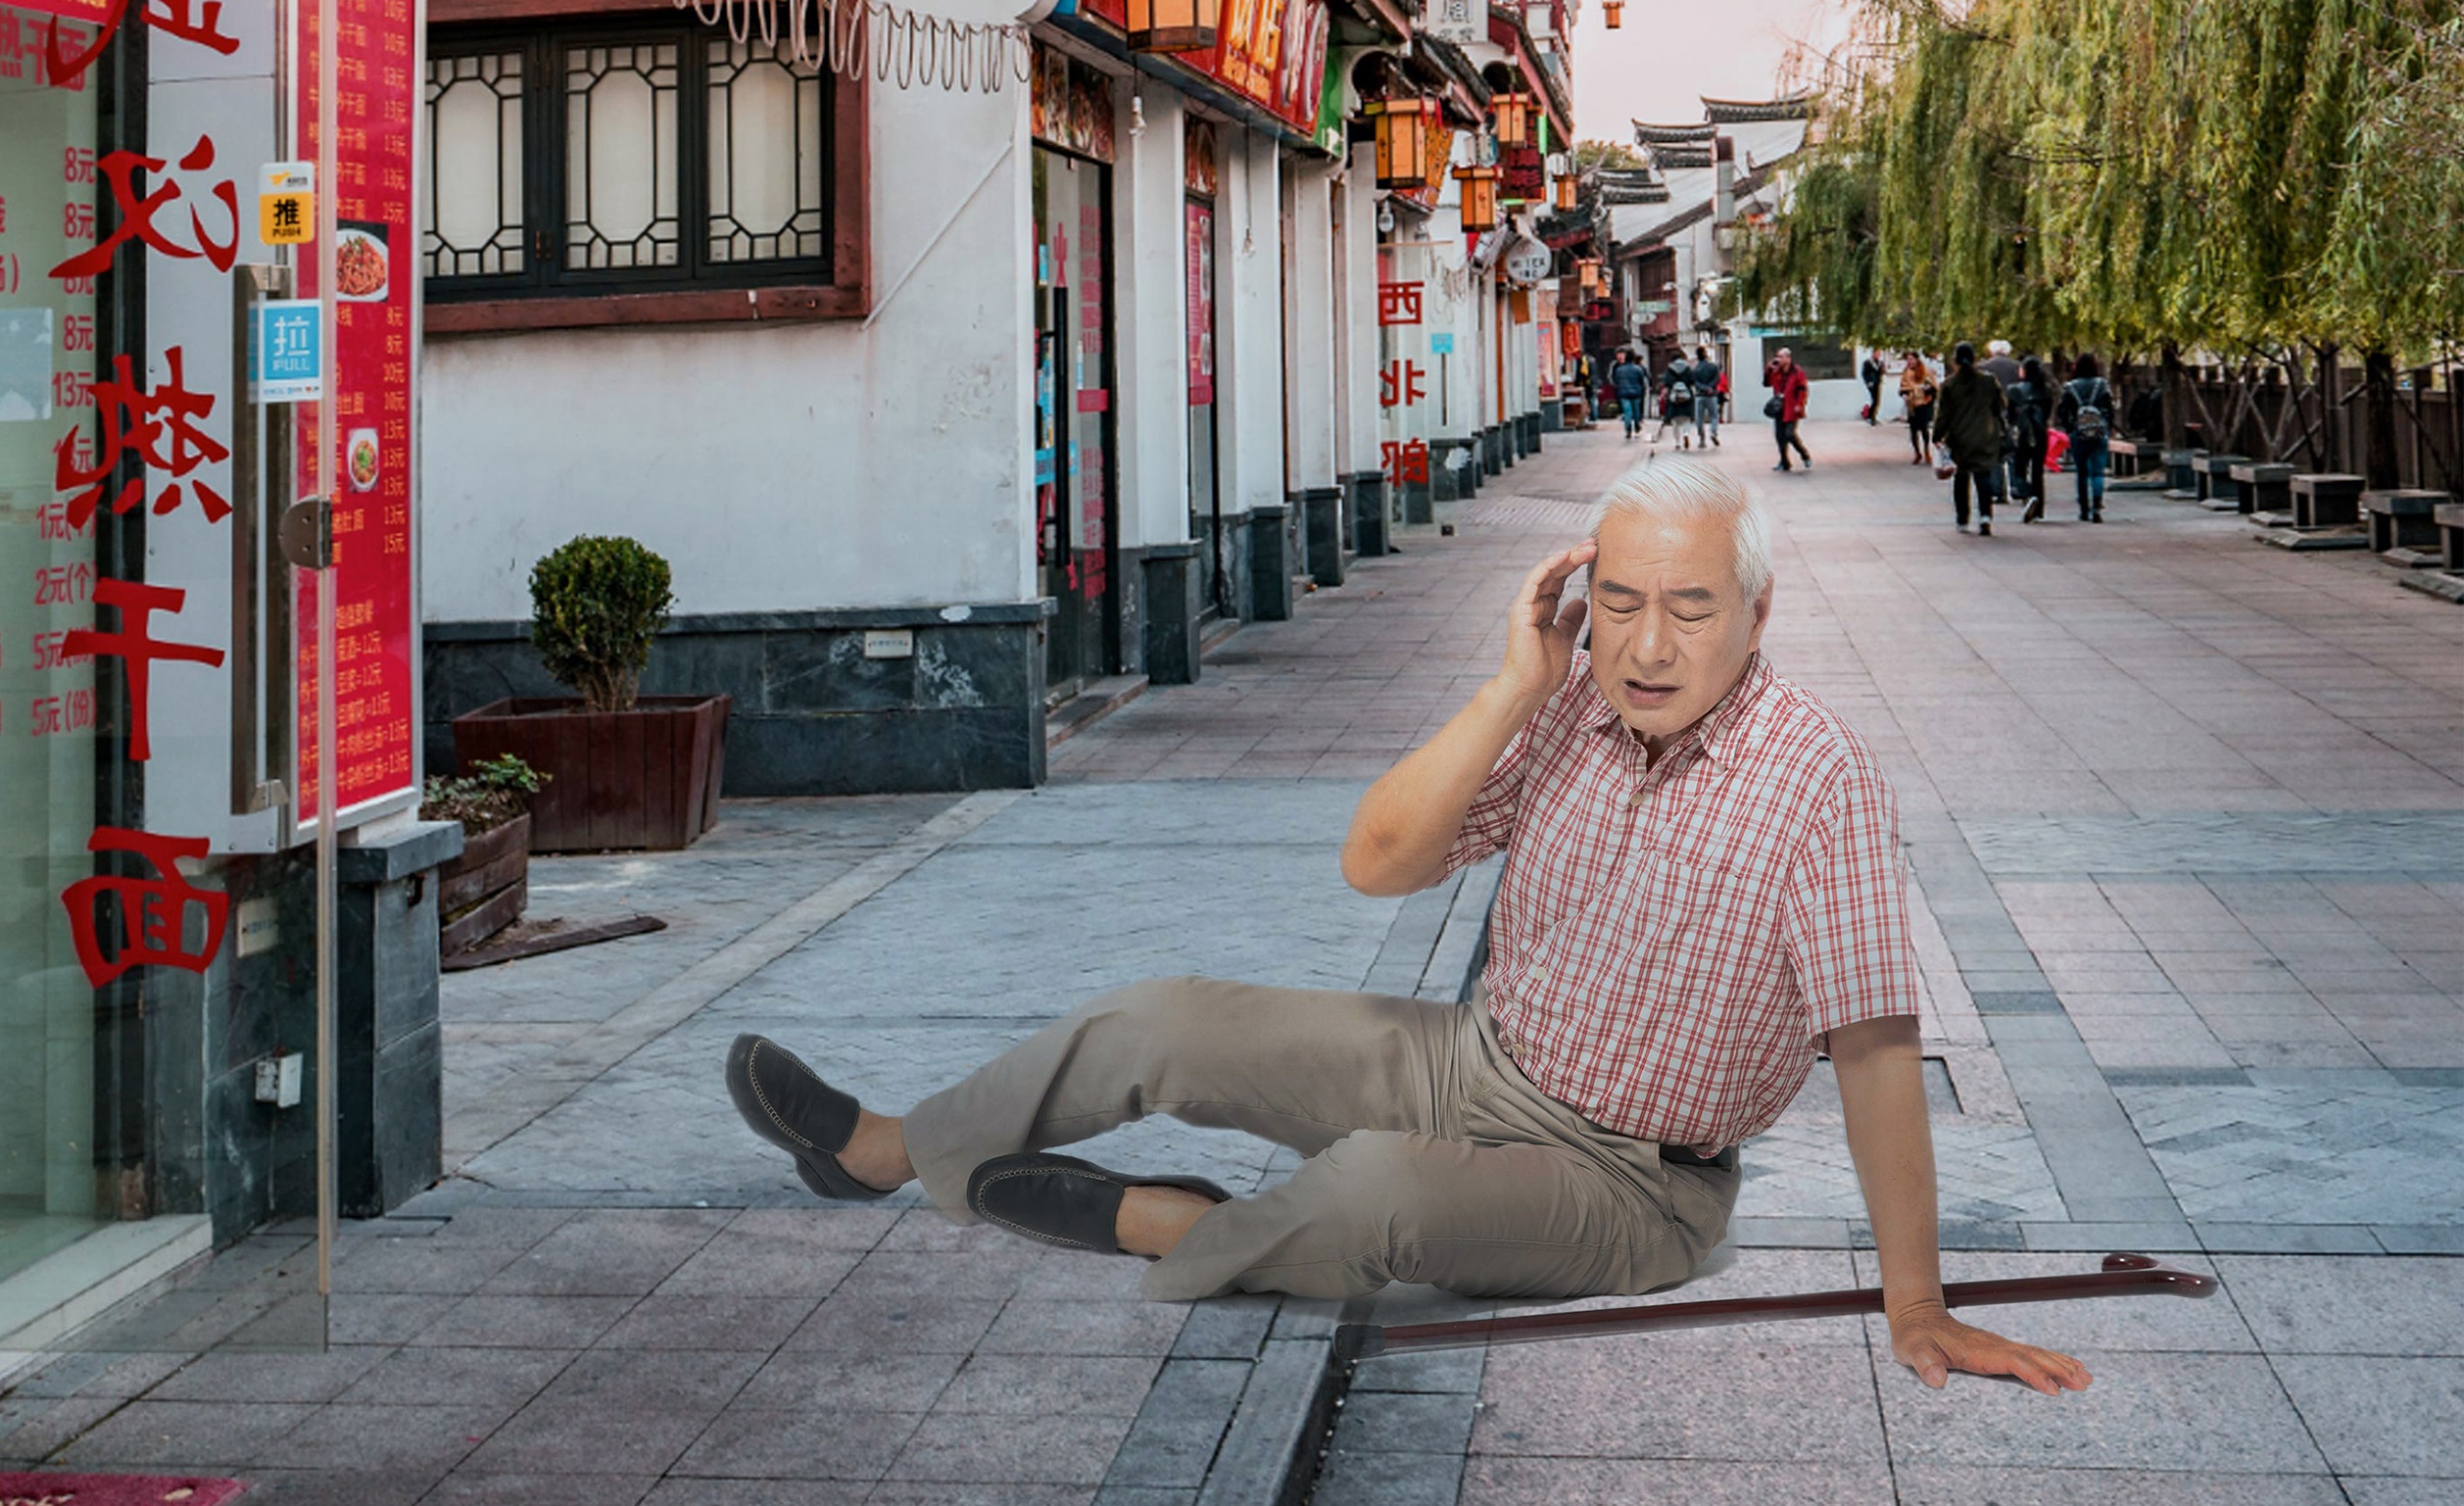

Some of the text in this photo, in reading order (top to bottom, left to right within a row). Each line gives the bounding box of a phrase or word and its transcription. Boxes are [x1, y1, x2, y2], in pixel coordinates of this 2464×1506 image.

[64, 147, 96, 183] 8元
[64, 203, 95, 239] 8元
[273, 198, 301, 226] 推
[63, 314, 94, 351] 8元
[274, 315, 311, 356] 拉
[273, 358, 311, 371] PULL
[52, 372, 94, 407] 13元
[36, 503, 96, 542] 1元()
